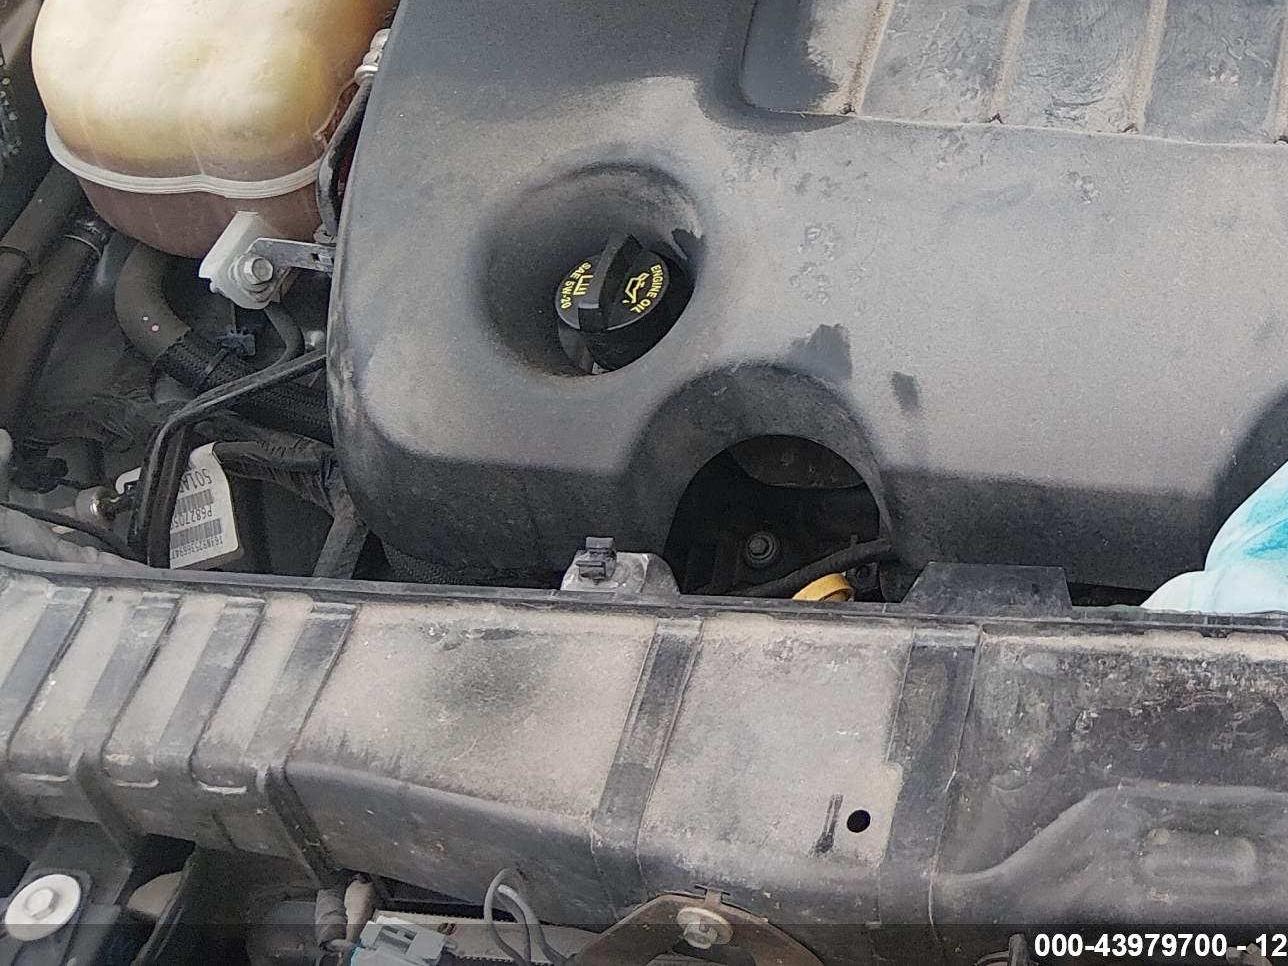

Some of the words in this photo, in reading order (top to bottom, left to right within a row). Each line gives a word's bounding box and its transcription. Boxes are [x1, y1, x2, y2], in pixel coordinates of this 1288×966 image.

[569, 262, 592, 280] SAE
[646, 264, 664, 299] ENGINE
[560, 280, 576, 309] 5W-20
[629, 298, 652, 314] OIL
